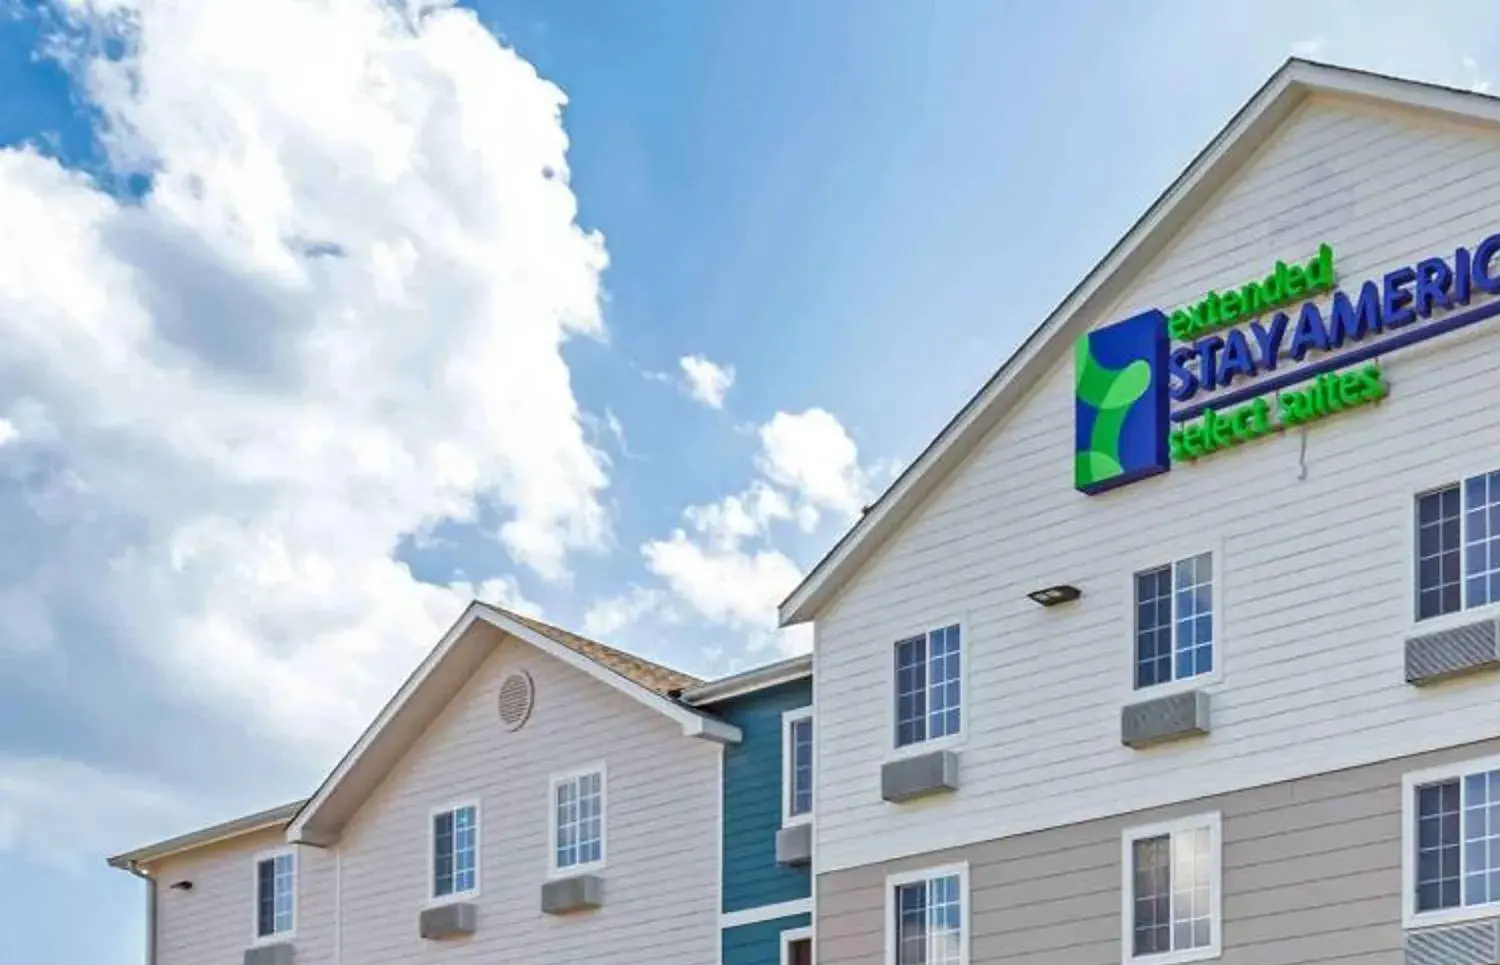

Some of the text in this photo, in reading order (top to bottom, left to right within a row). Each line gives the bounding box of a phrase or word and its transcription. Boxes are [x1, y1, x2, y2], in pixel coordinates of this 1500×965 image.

[1170, 243, 1333, 340] extended
[1170, 364, 1386, 461] select suites
